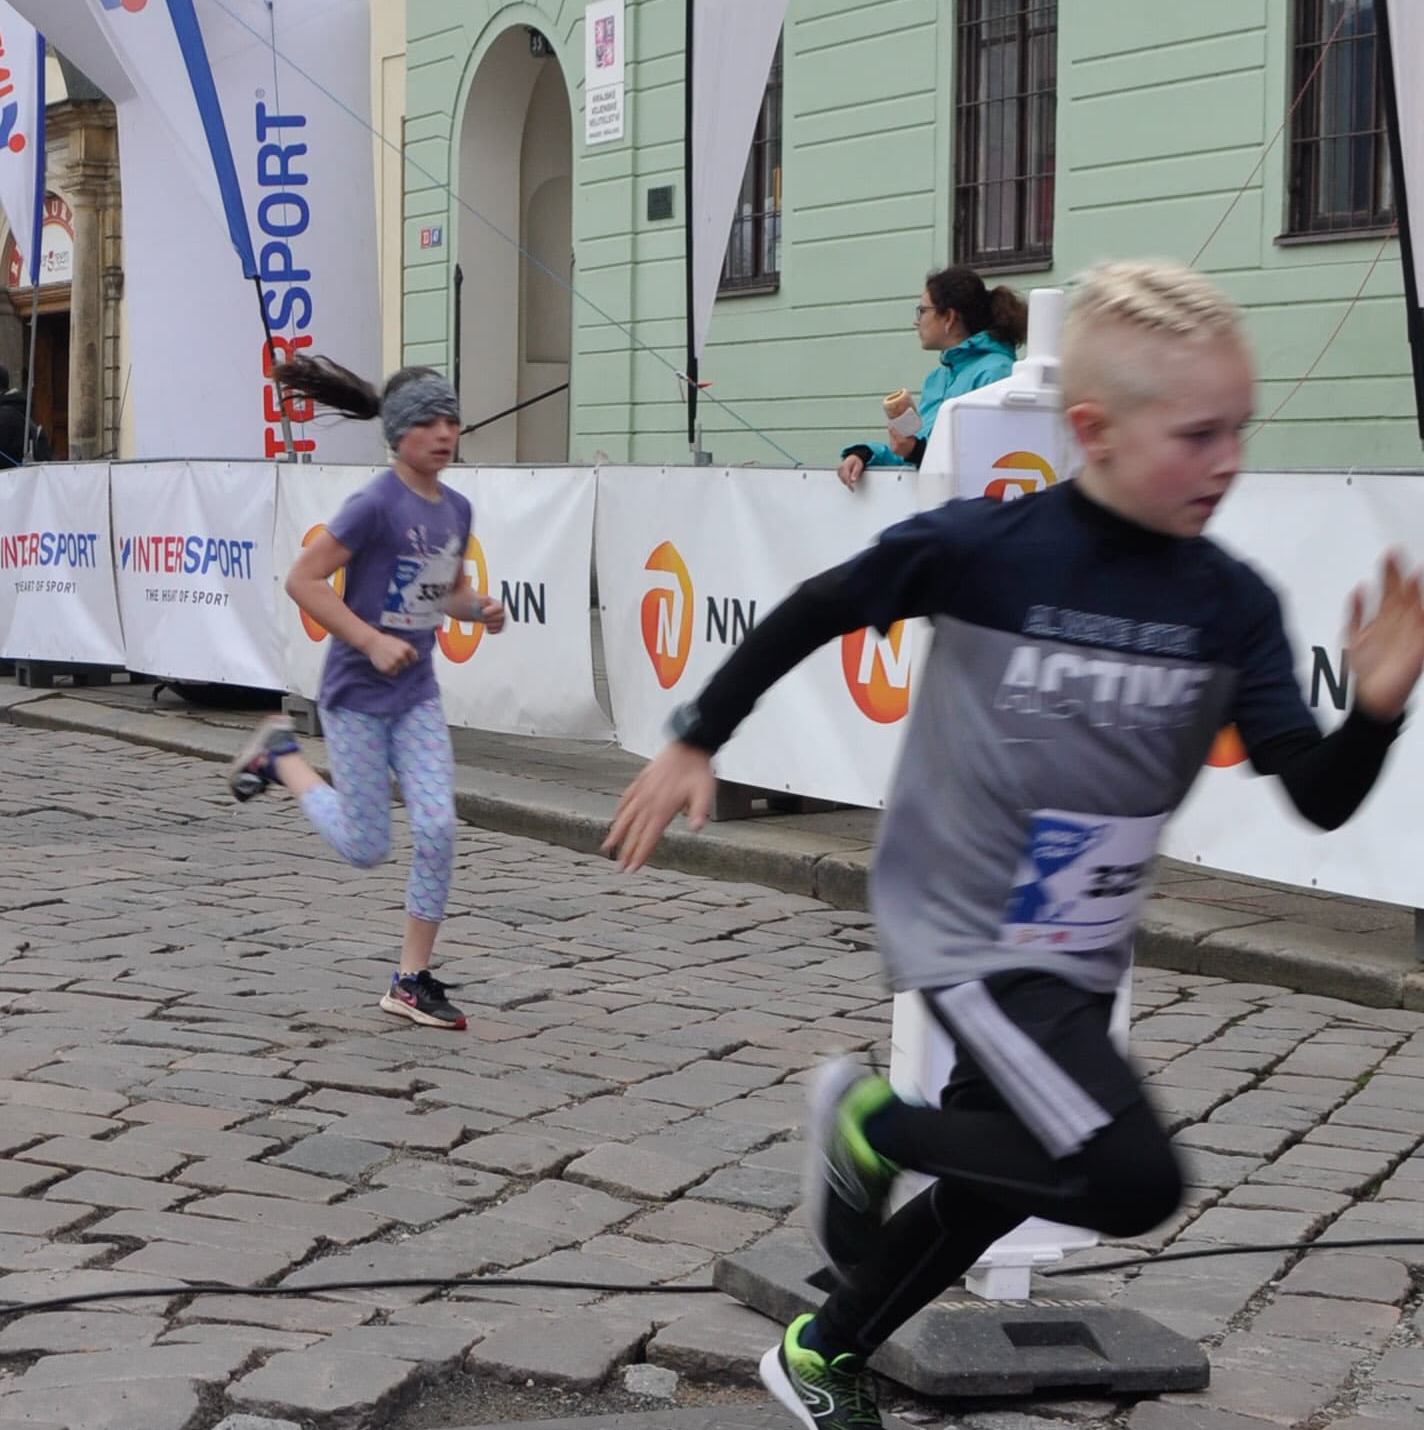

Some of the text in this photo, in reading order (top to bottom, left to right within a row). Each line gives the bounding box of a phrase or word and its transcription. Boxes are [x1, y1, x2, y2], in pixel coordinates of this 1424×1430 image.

[256, 101, 316, 459] TERSPORT
[0, 532, 97, 569] INTERSPORT
[133, 535, 255, 580] INTERSPORT
[46, 580, 77, 594] SPORT
[192, 590, 229, 606] SPORT
[501, 580, 546, 624] NN
[706, 596, 756, 645] NN
[1310, 645, 1349, 711] N
